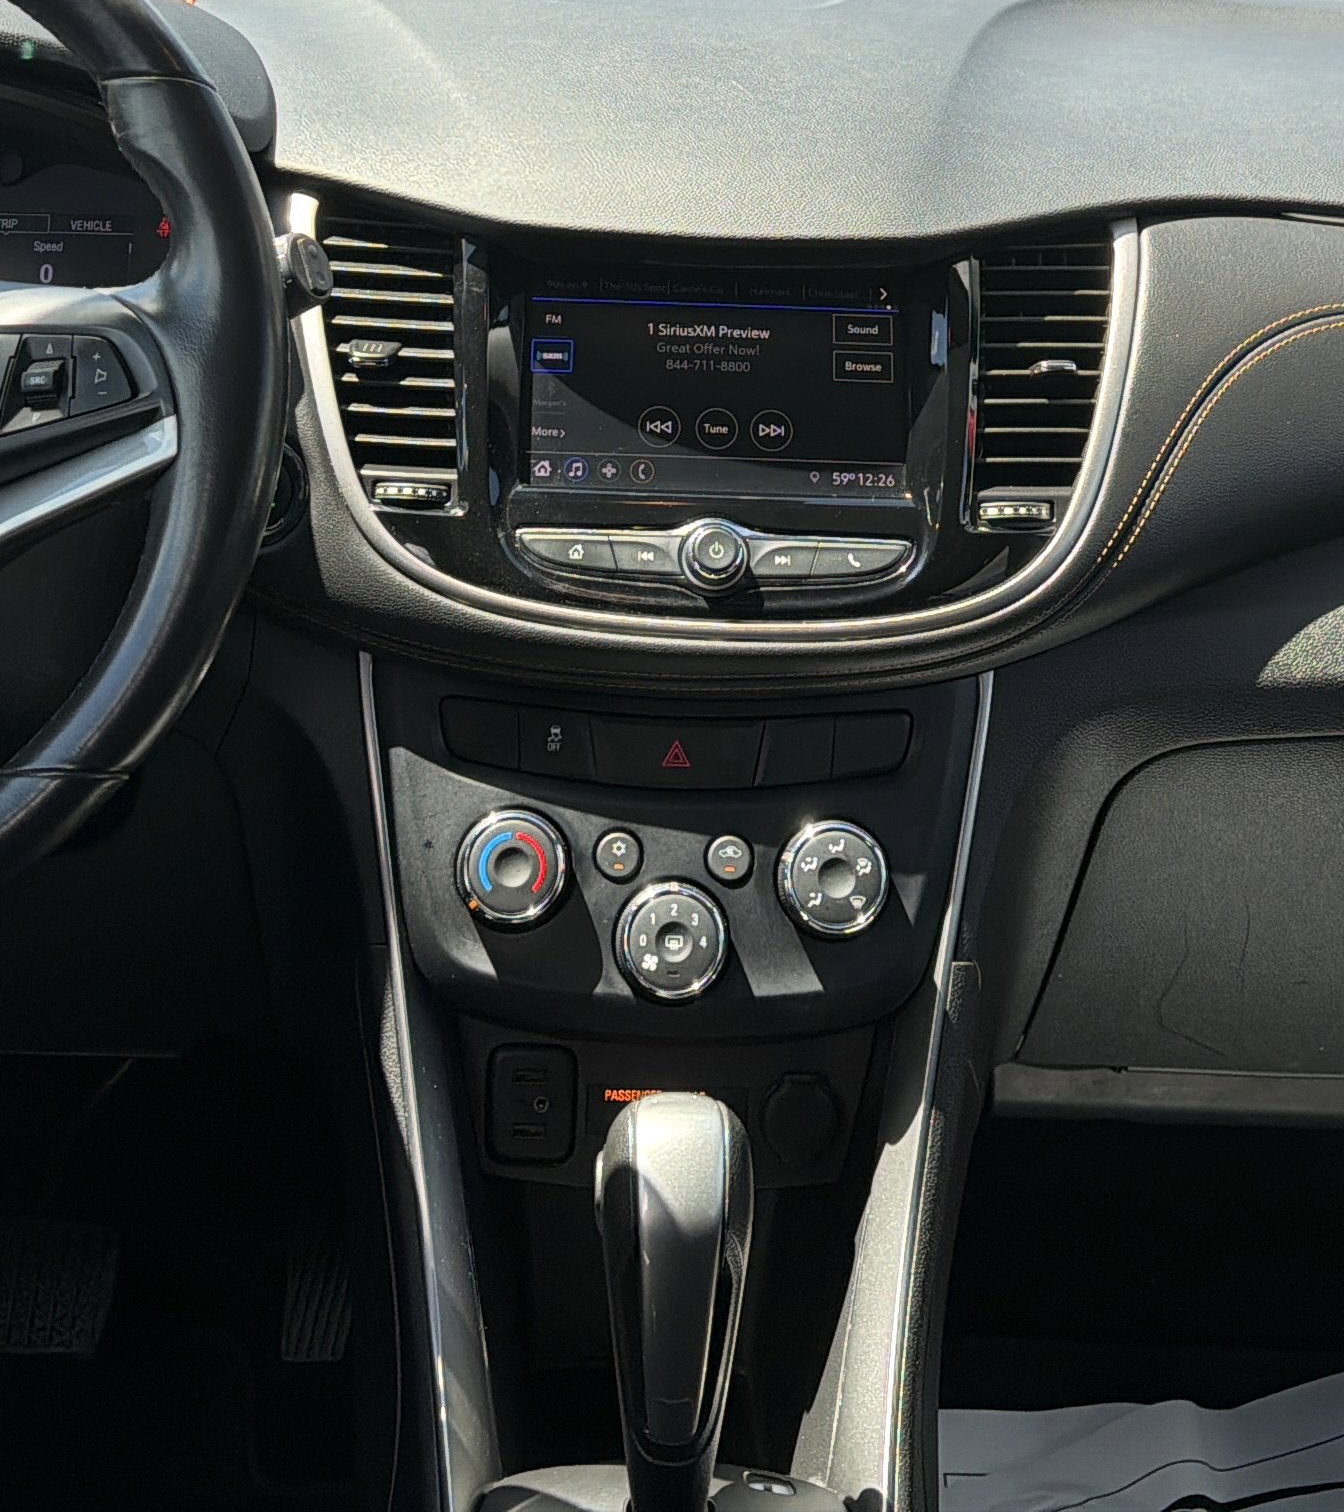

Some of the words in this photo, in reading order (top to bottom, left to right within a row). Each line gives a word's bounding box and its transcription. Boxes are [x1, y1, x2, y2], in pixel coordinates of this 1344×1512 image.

[70, 220, 113, 232] VEHICLE
[33, 241, 64, 253] Speed
[39, 263, 53, 284] 0
[545, 314, 562, 325] FM
[647, 323, 655, 336] 1
[658, 323, 716, 338] SiriusXM
[719, 325, 771, 341] Preview
[846, 324, 879, 336] Sound
[656, 342, 693, 355] Great
[695, 342, 726, 355] Offer
[728, 344, 761, 356] Now!
[665, 359, 751, 373] 844-711-8800
[844, 361, 882, 373] Browse
[29, 375, 46, 385] SRC
[531, 427, 559, 437] More
[703, 424, 729, 435] Tune
[856, 473, 896, 487] 12:26
[546, 740, 562, 752] OFF
[670, 903, 678, 917] 2
[650, 913, 656, 926] 1
[691, 912, 699, 926] 3
[638, 933, 647, 947] 0
[698, 935, 707, 949] 4
